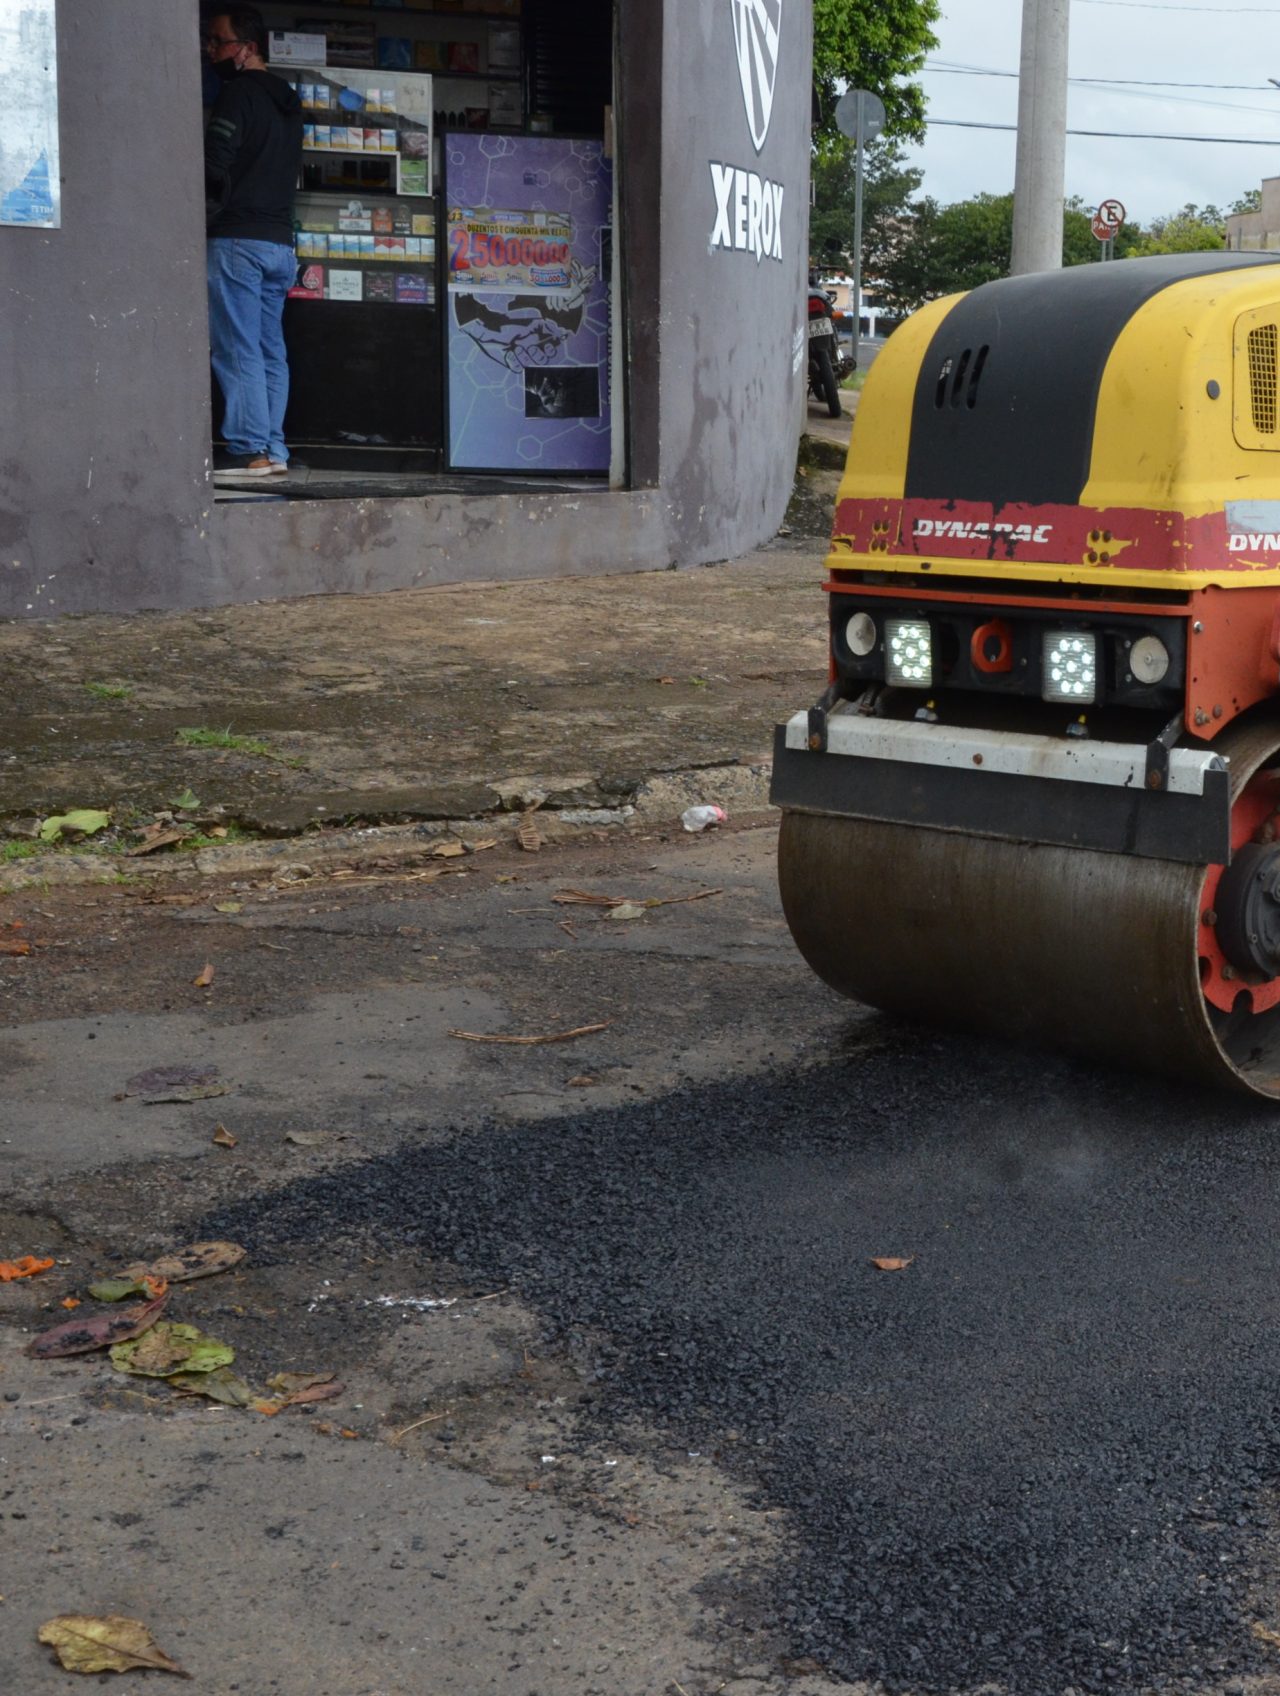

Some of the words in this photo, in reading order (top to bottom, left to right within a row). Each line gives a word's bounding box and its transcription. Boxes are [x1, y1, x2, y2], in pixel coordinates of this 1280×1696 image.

[710, 163, 784, 263] XEROX
[1107, 205, 1117, 221] E
[467, 224, 498, 233] DUZENTOS
[505, 225, 538, 235] CINQUENTA
[913, 519, 1054, 544] DYNAPAC
